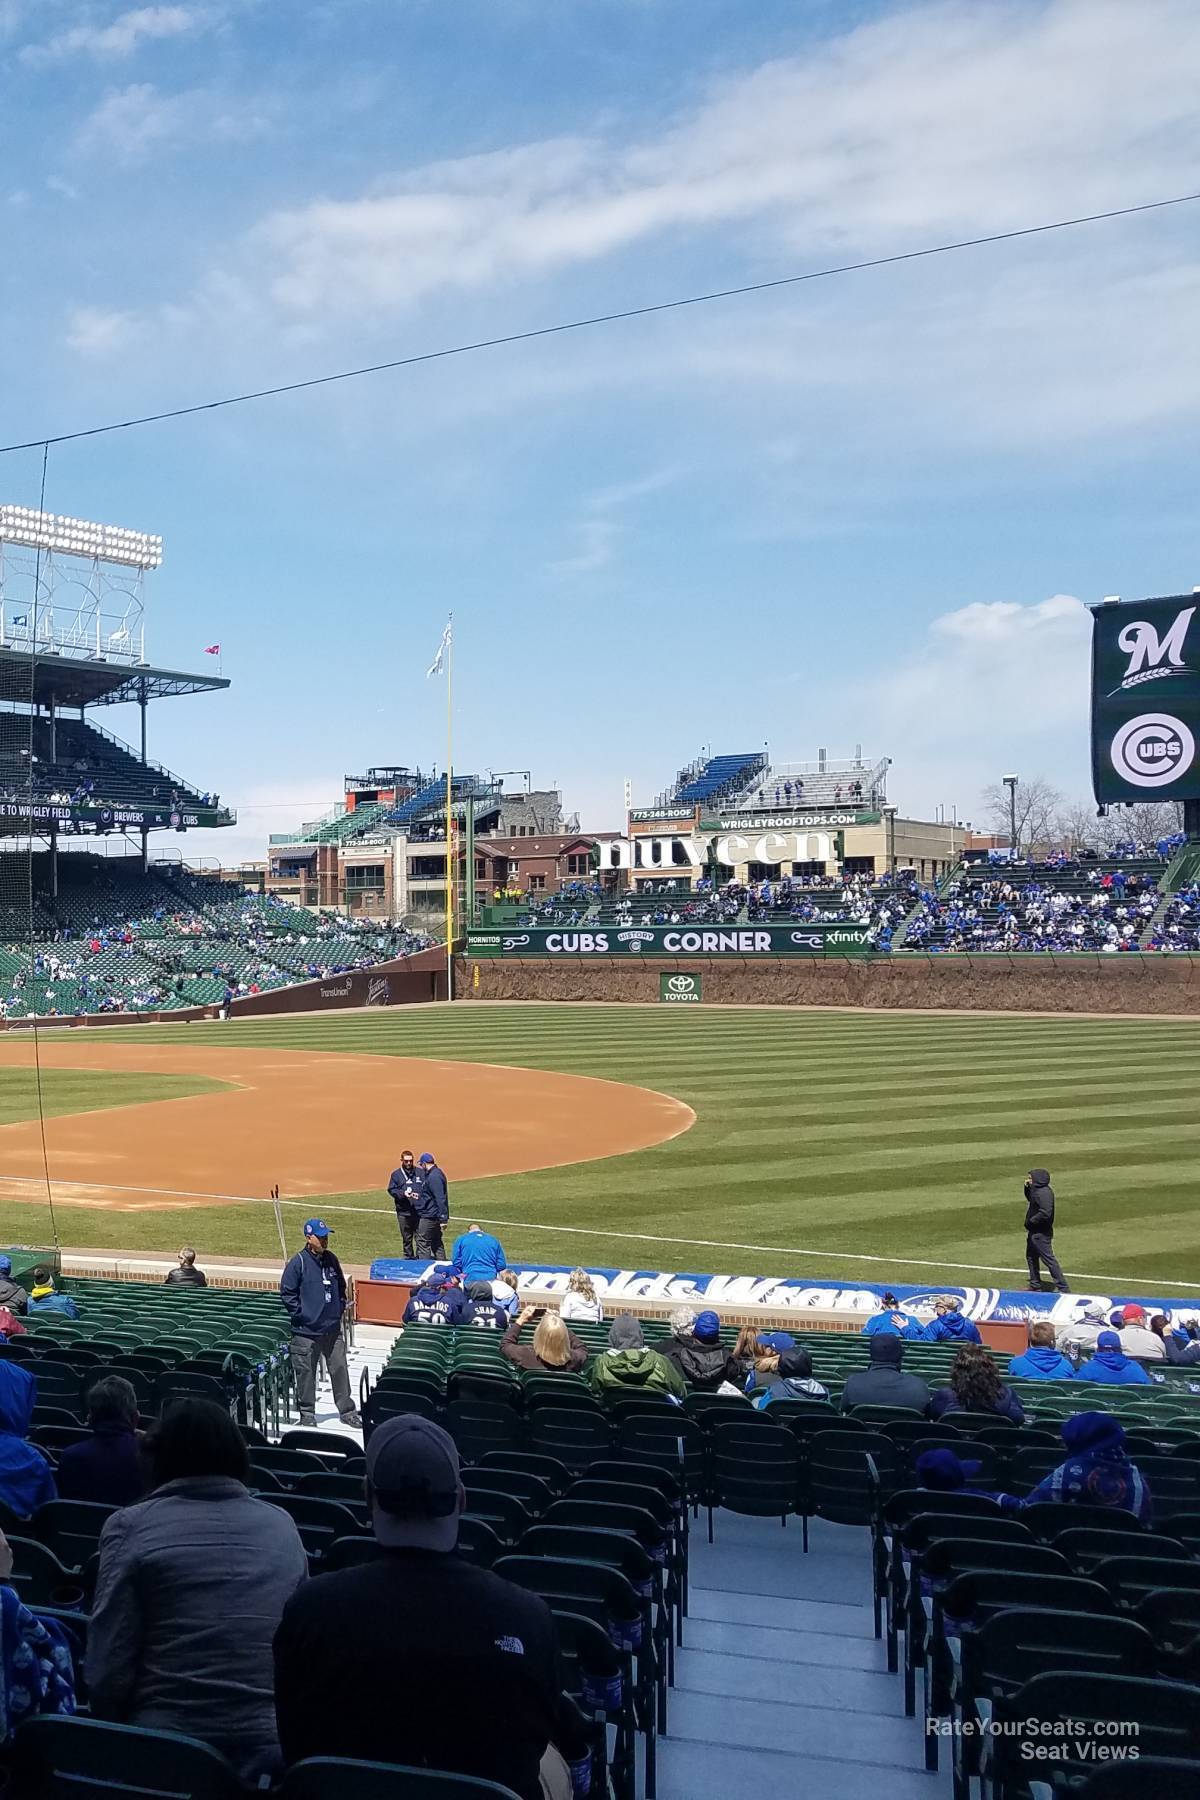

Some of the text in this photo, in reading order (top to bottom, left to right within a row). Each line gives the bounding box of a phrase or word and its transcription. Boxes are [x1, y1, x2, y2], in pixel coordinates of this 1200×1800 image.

[7, 804, 17, 816] TO
[19, 805, 50, 818] WRIGLEY
[52, 807, 71, 818] FIELD
[113, 811, 144, 823] BREWERS
[182, 815, 199, 825] CUBS
[633, 808, 692, 819] 773-248-ROOF
[721, 815, 856, 829] WRIGLEYROOFTOPS.COM
[596, 831, 836, 869] nuveen
[468, 936, 500, 944] HORNITOS
[545, 933, 609, 952] CUBS
[618, 931, 654, 941] HISTORY
[663, 932, 772, 951] CORNER
[826, 930, 867, 945] xfinity
[320, 986, 349, 998] TransUnion
[664, 993, 699, 1001] TOYOTA
